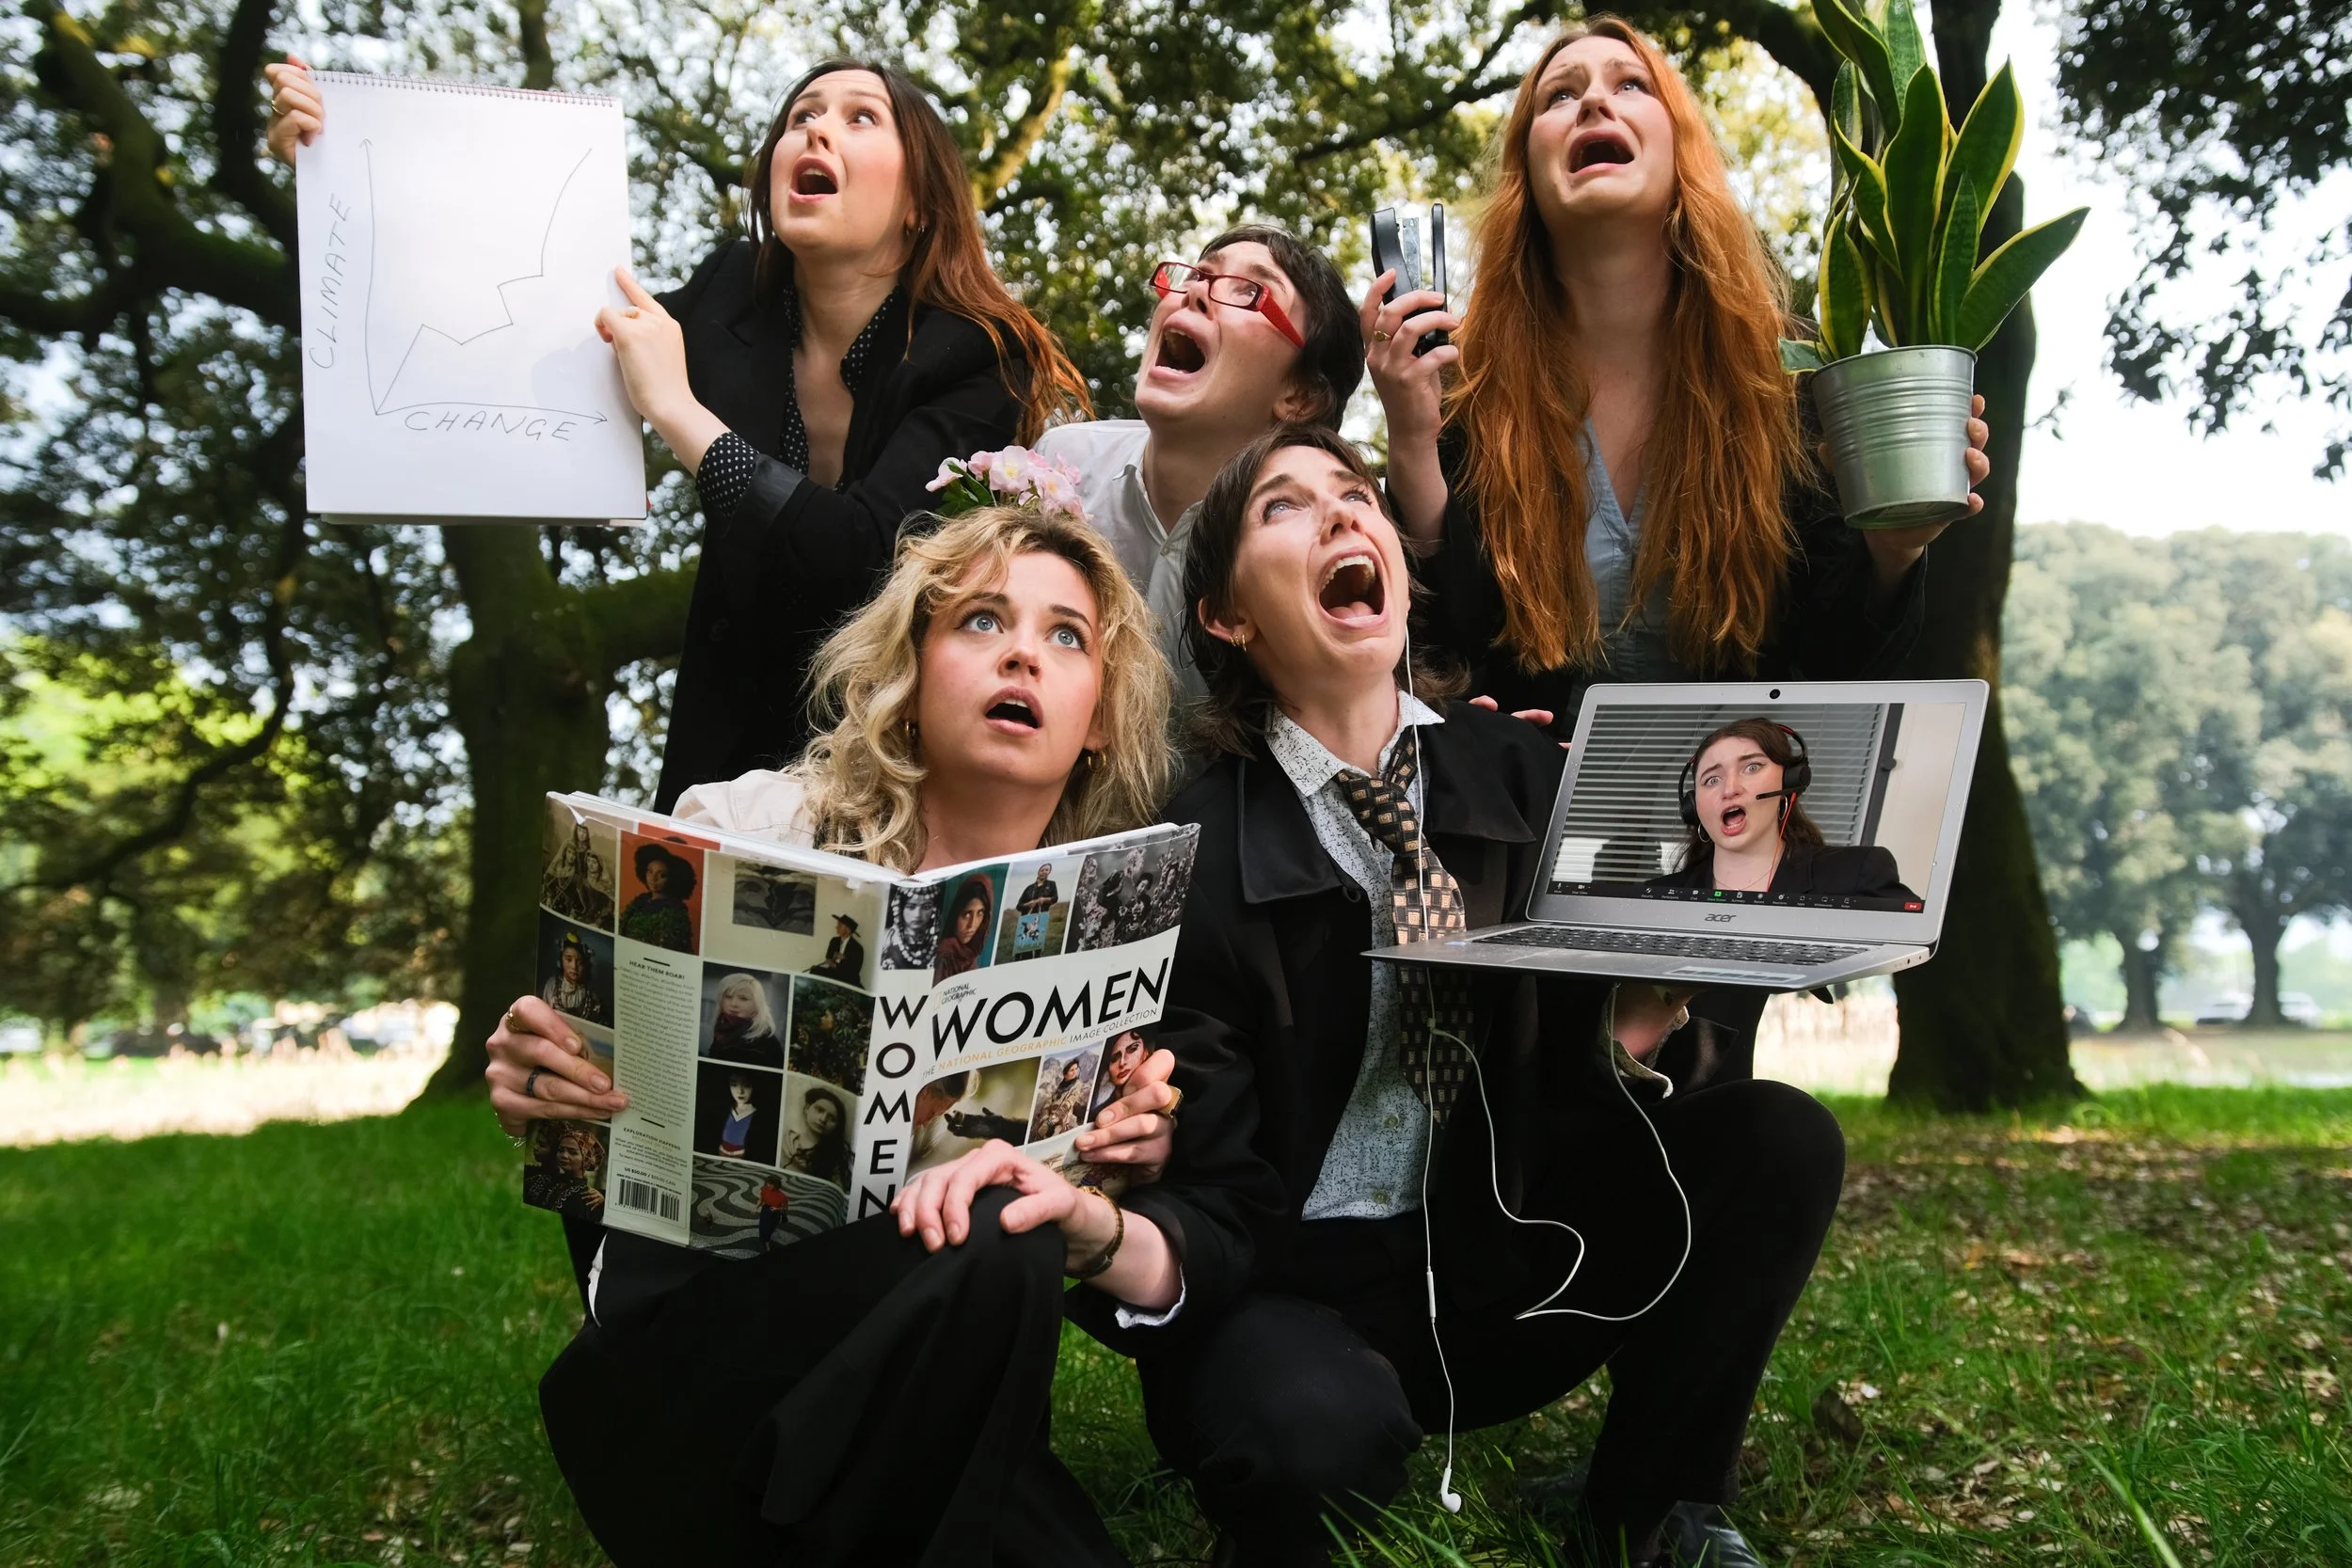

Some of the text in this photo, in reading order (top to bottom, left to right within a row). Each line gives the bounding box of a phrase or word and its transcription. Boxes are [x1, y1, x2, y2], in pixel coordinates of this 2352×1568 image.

[309, 193, 351, 368] CLIMATE
[405, 410, 577, 441] CHANGE
[1705, 913, 1737, 923] acer
[628, 960, 645, 970] HEAR
[647, 966, 664, 974] THEM
[941, 988, 977, 1005] GEOGRAPHIC
[942, 983, 970, 997] NATIONAL
[932, 957, 1169, 1061] WOMEN
[923, 1007, 1158, 1080] THE NATIONAL GEOGRAPHIC IMAGE COLLECTION
[857, 995, 929, 1219] WOMEN
[623, 1127, 658, 1142] EXPLORATION
